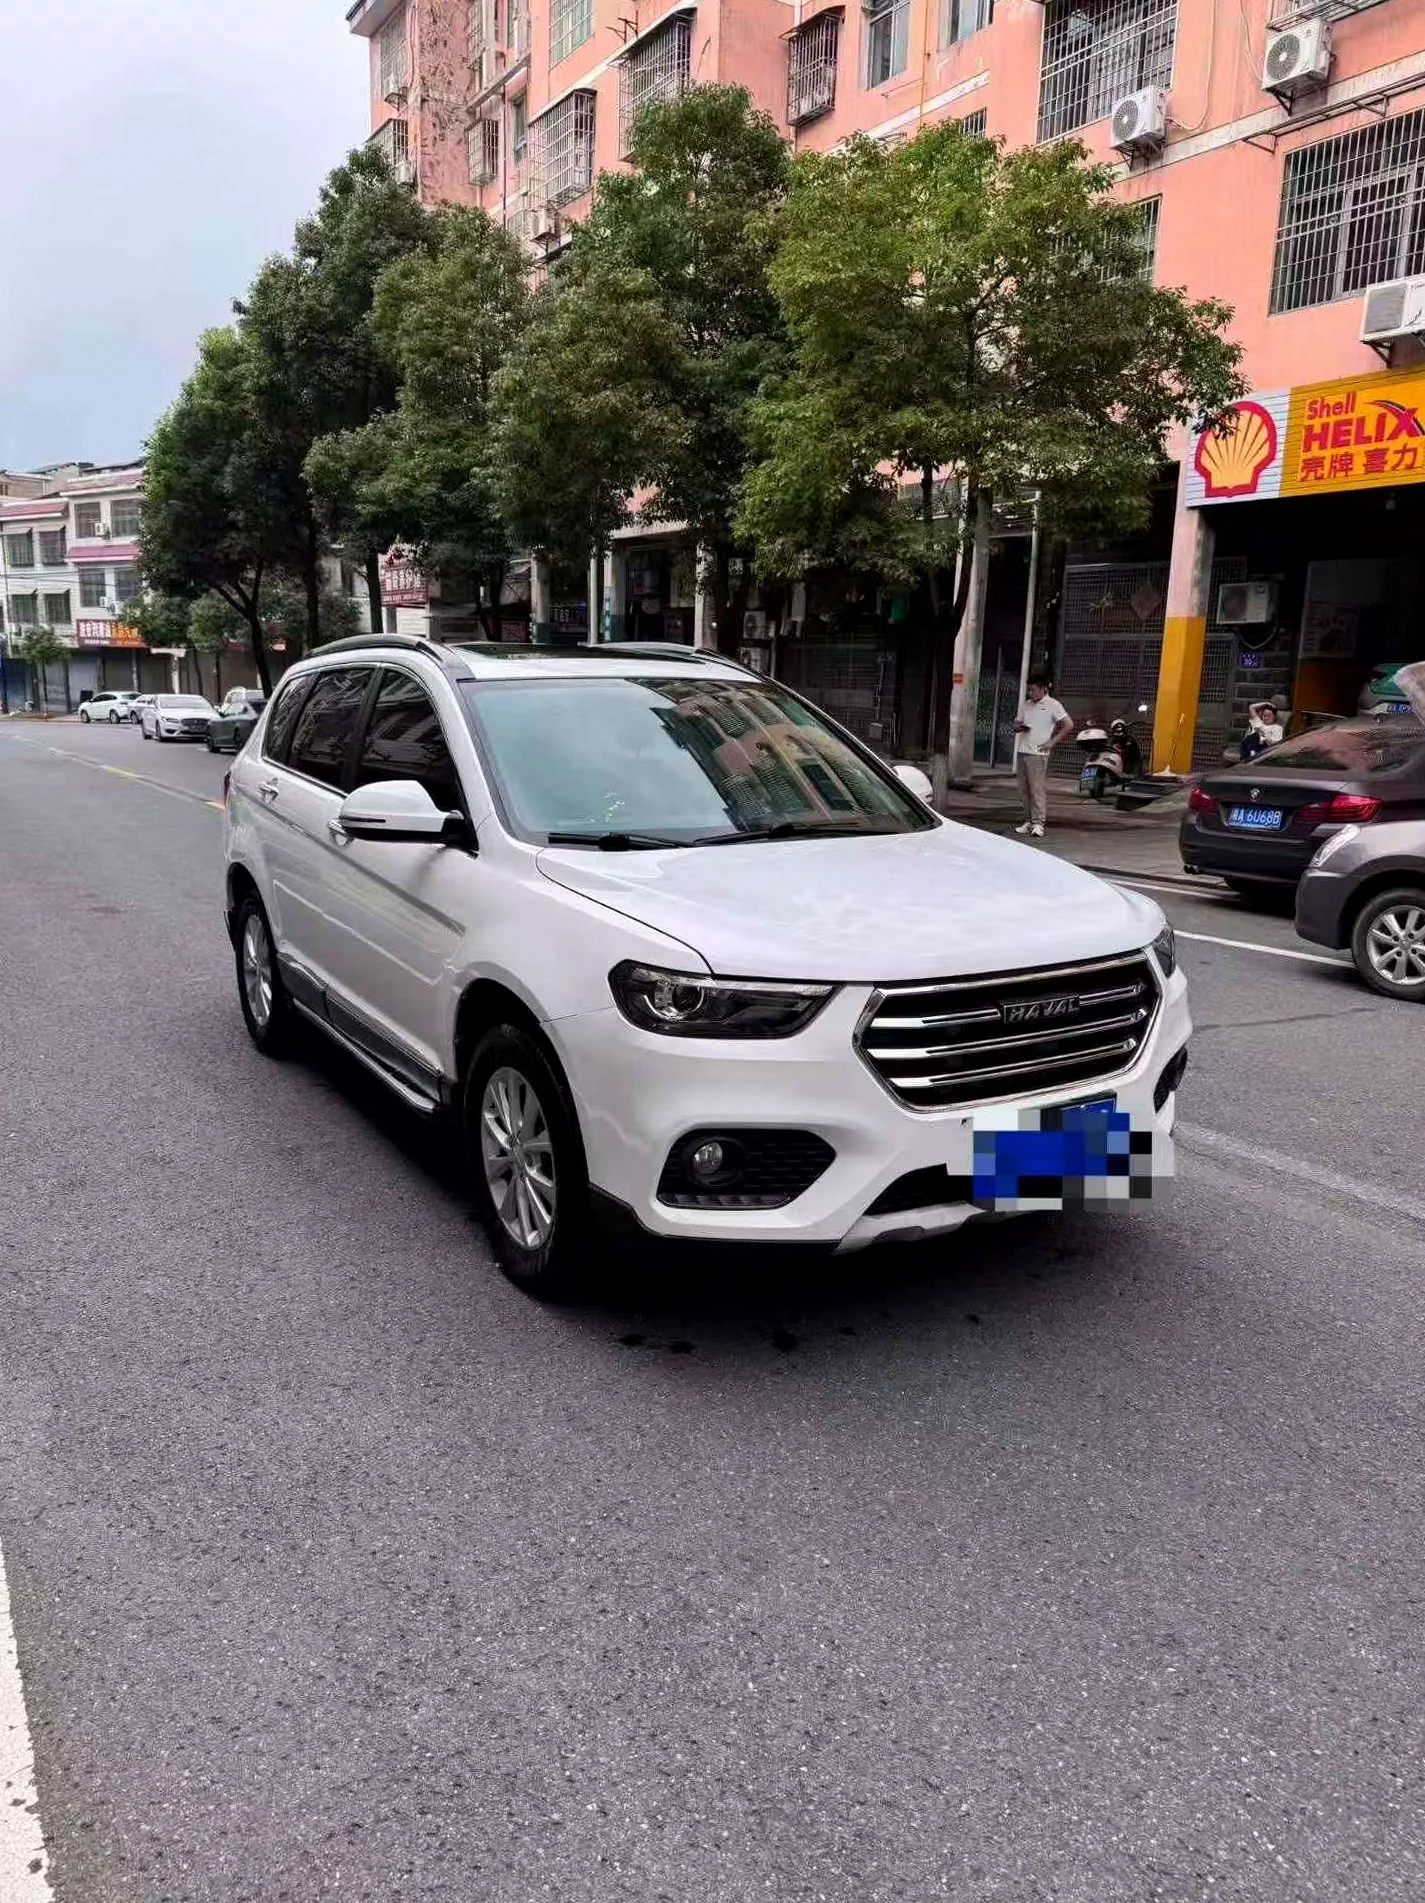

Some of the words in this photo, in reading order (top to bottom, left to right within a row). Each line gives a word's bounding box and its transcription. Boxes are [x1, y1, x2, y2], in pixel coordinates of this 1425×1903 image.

[1306, 391, 1357, 420] Shell
[1302, 402, 1425, 453] HELIX
[1300, 443, 1418, 481] 壳牌喜力
[1008, 999, 1079, 1021] HAVAL
